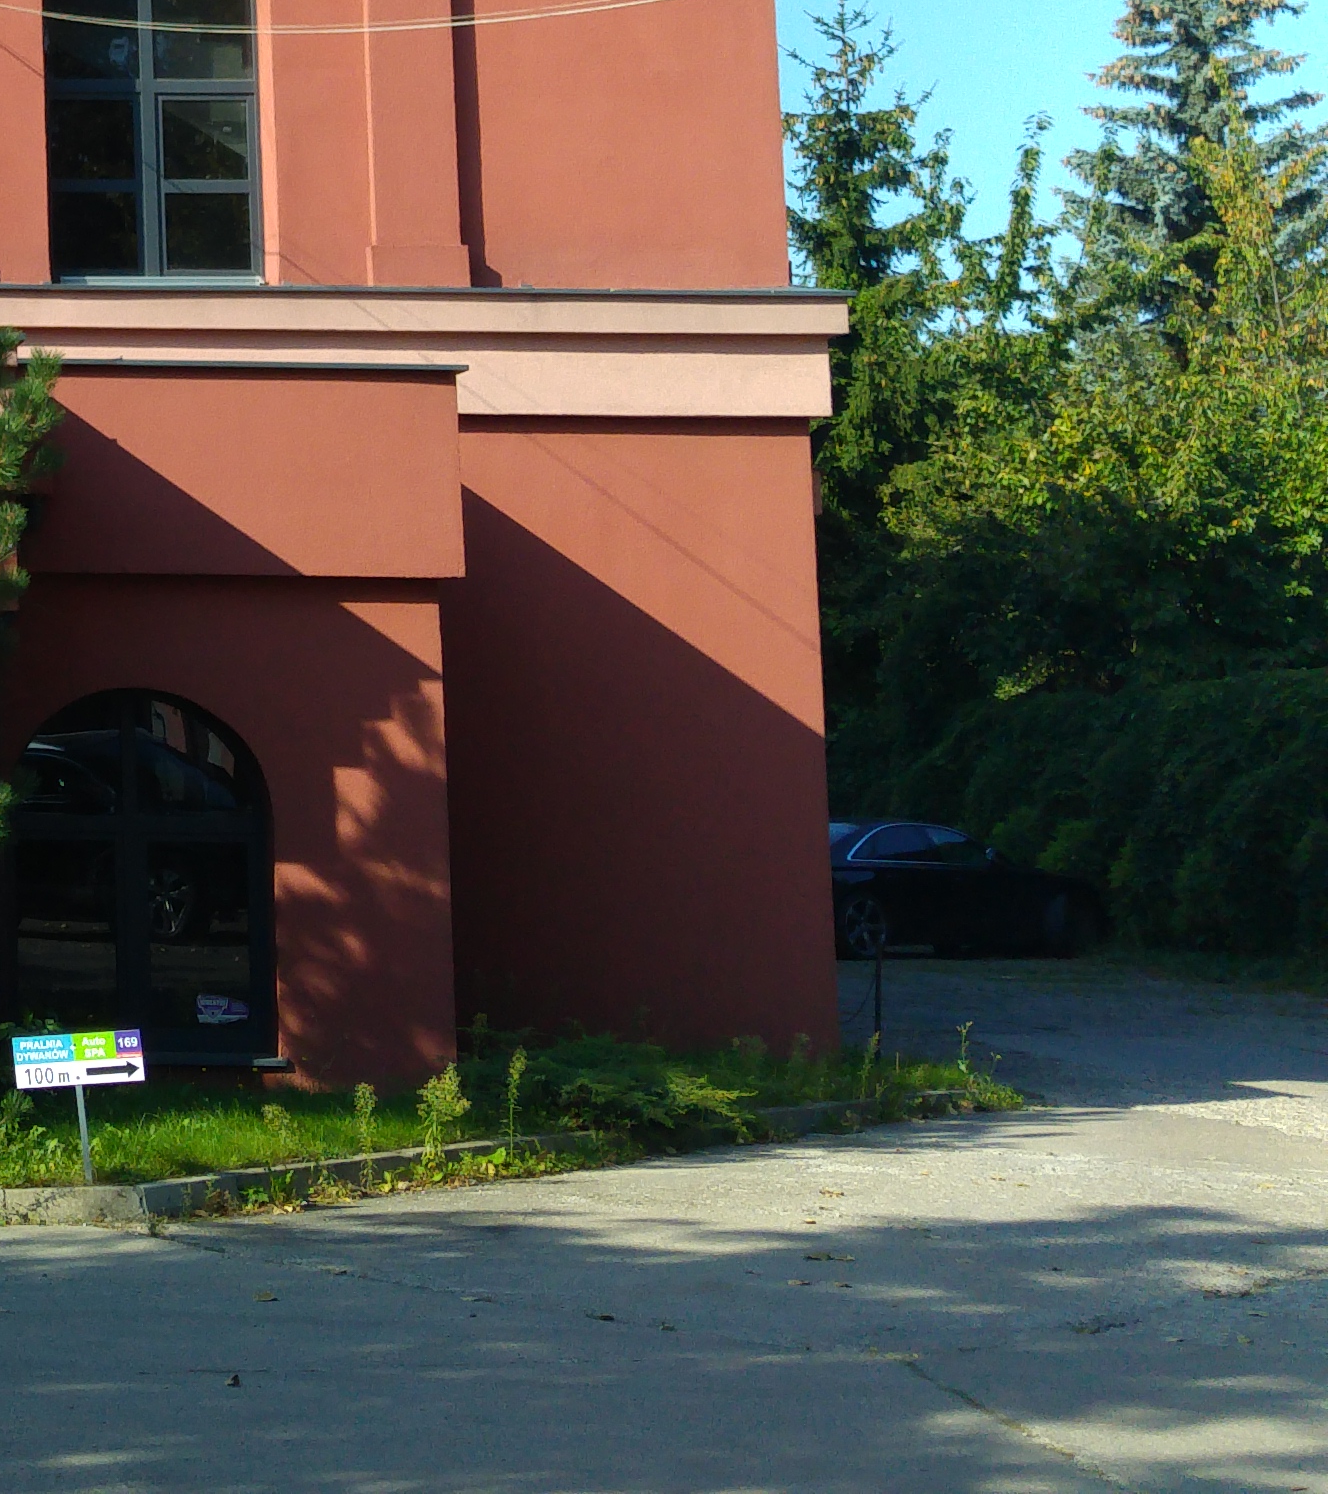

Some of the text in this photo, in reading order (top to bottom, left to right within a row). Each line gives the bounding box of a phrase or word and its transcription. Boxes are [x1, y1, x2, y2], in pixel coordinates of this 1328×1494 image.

[19, 1039, 63, 1051] PRALNIA
[81, 1036, 106, 1047] Auto
[117, 1036, 139, 1049] 169
[15, 1049, 70, 1062] DYWANÓW
[84, 1047, 106, 1058] SPA
[24, 1067, 54, 1086] 100
